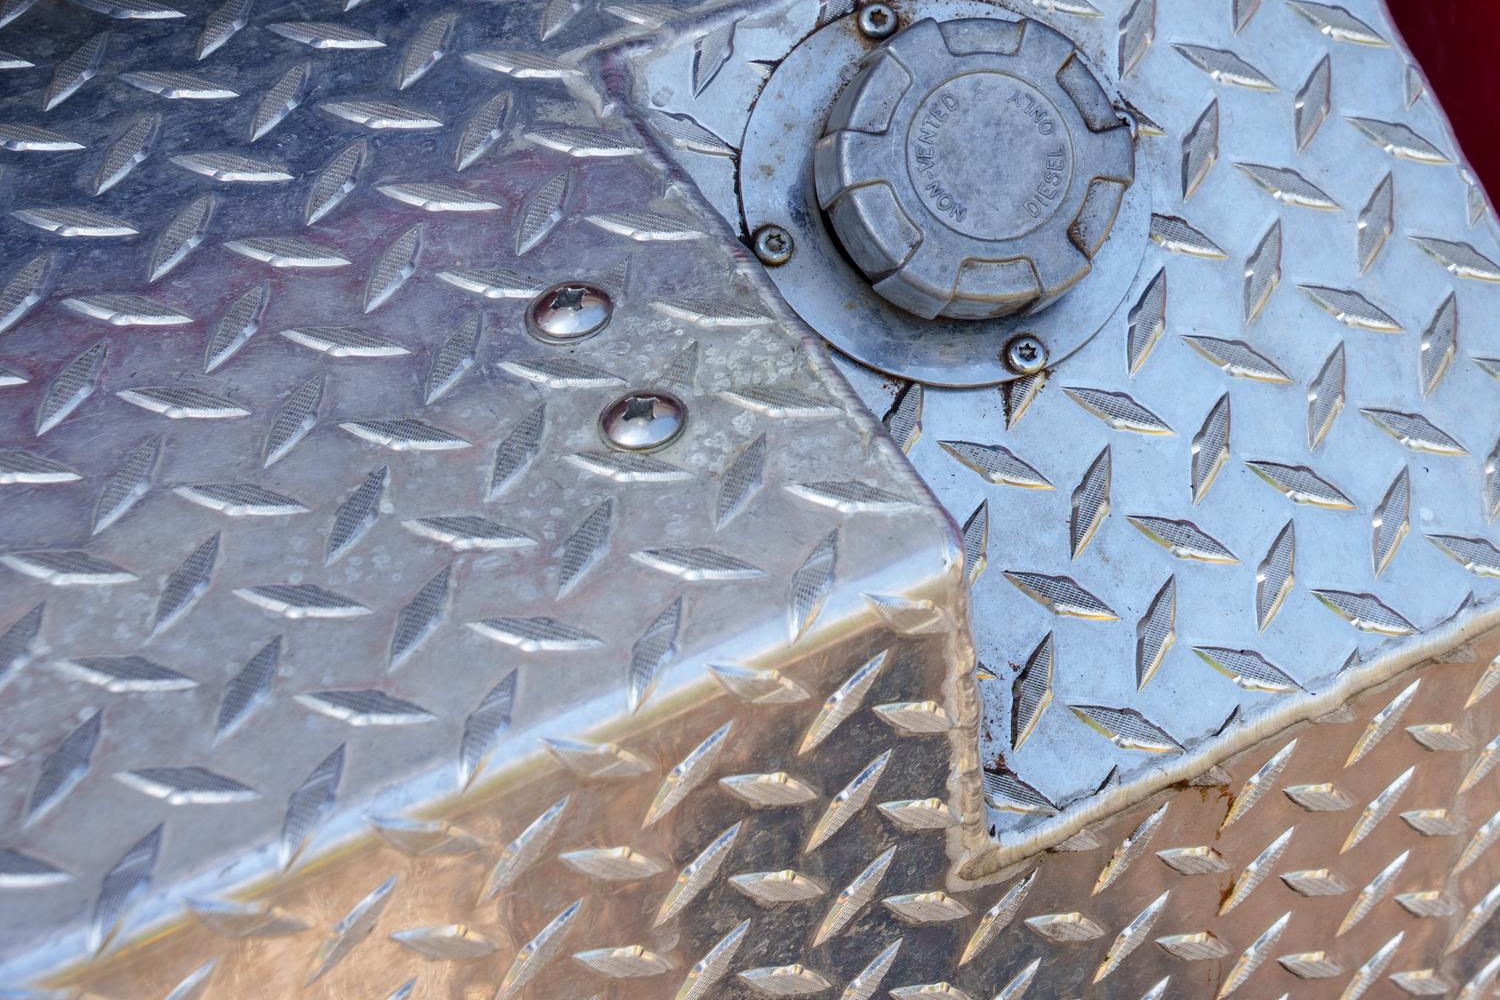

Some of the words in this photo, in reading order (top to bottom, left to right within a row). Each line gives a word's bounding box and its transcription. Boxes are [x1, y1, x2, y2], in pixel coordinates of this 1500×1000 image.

[1007, 89, 1056, 136] ONLY
[915, 92, 968, 223] NON-VENTED
[1023, 144, 1066, 219] DIESEL
